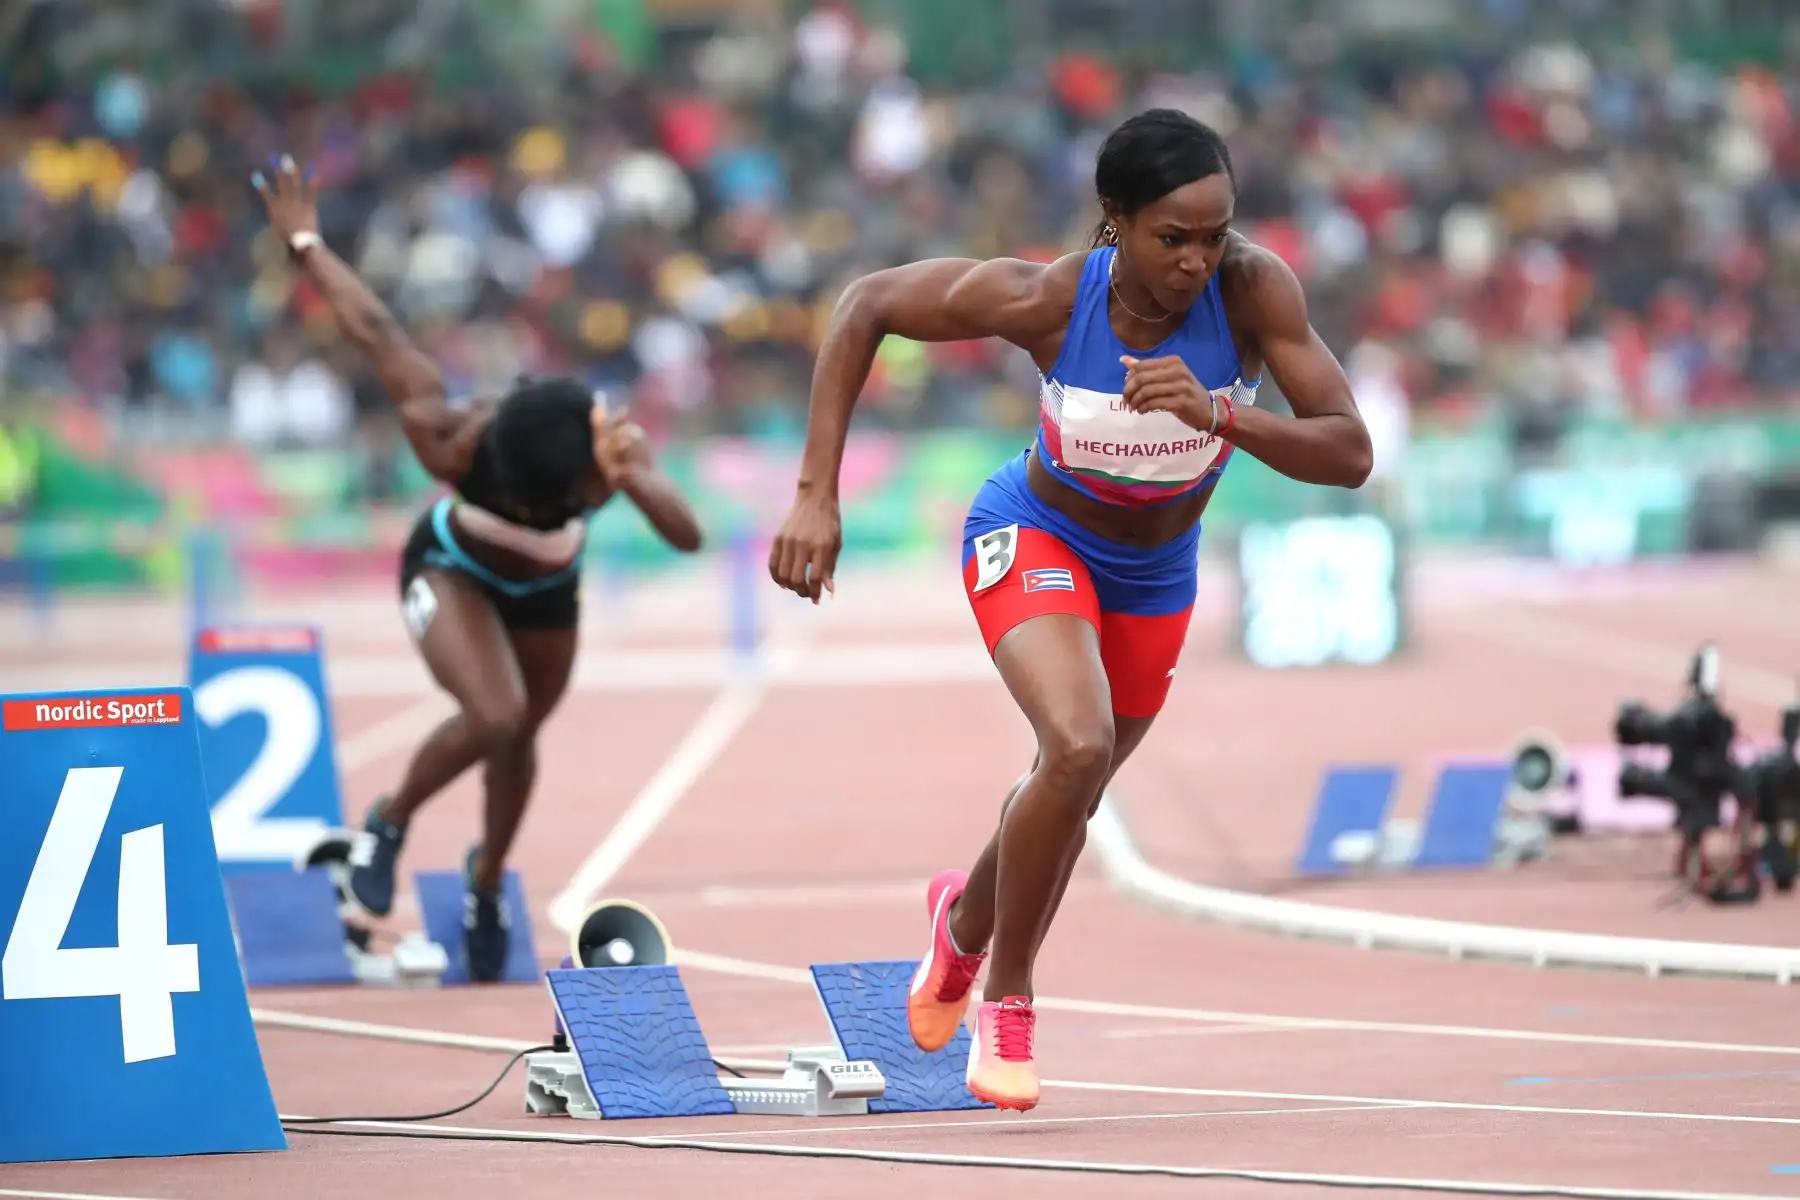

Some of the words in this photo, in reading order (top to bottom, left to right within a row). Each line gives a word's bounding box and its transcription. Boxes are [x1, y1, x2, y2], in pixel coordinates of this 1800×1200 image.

[1075, 434, 1216, 457] HECHAVARRIA
[36, 700, 103, 721] nordic
[107, 699, 165, 723] Sport
[194, 665, 325, 862] 2
[2, 766, 200, 1064] 4
[830, 1064, 873, 1073] GILL
